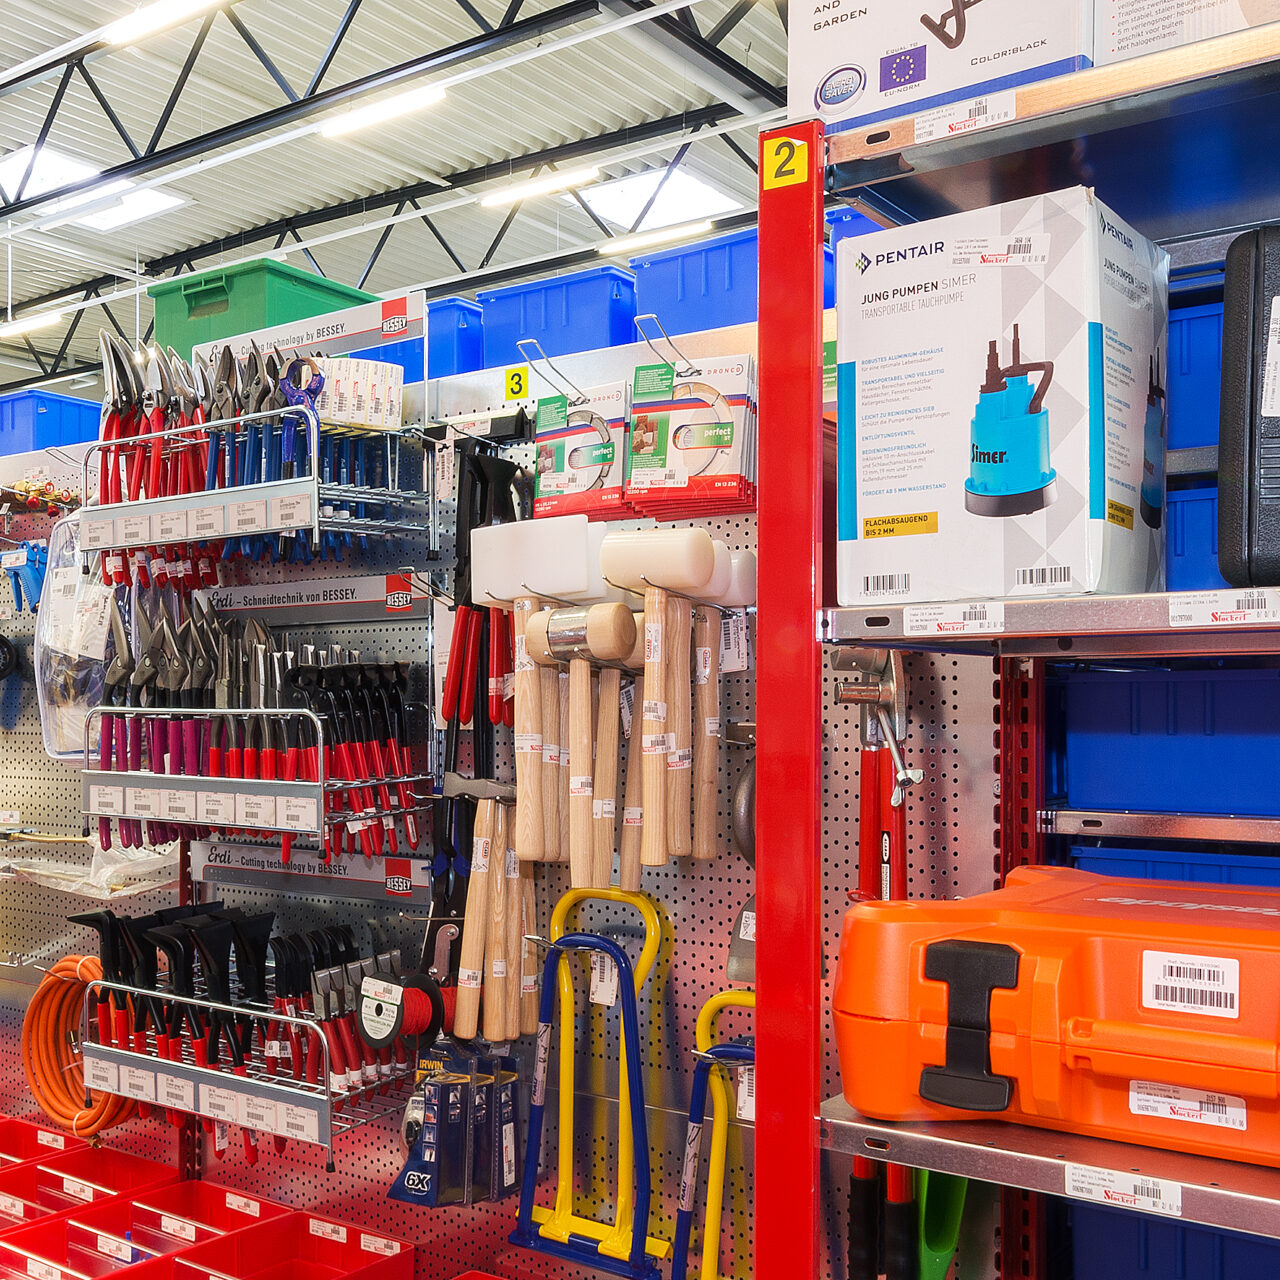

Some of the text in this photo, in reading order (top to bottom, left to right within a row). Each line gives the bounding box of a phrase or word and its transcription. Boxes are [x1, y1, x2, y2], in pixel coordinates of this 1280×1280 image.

[813, 0, 841, 15] AND
[813, 7, 868, 31] GARDEN
[1145, 26, 1160, 35] voor
[885, 45, 908, 55] EQUAL
[1117, 43, 1129, 51] Met
[824, 75, 856, 91] ENERGY
[884, 83, 921, 97] EU-NORM
[824, 85, 854, 100] SAVER
[773, 141, 796, 178] 2
[1106, 222, 1134, 251] PENTAIR
[875, 241, 945, 267] PENTAIR
[1103, 257, 1116, 274] JUNG
[1116, 265, 1135, 286] PUMPEN
[861, 273, 977, 305] JUNG PUMPEN SIMER
[861, 291, 964, 320] TRANSPORTABLE TAUCHPUMPE
[382, 317, 408, 333] BESSEY
[306, 332, 315, 341] by
[707, 366, 741, 375] DRONCO
[510, 373, 523, 395] 3
[703, 428, 731, 438] perfect
[592, 446, 613, 457] perfect
[971, 443, 1007, 464] Simer
[865, 515, 929, 527] FLACHABSAUGEND
[865, 526, 895, 537] BIS 2 MM
[210, 588, 357, 609] Erdi Schneidtechnik von BESSEY.
[386, 593, 412, 606] BESSEY
[207, 846, 234, 865] Erdi
[240, 856, 265, 868] Cutting
[307, 862, 316, 873] by
[386, 877, 411, 890] BESSEY
[419, 1060, 444, 1070] IRWIN
[405, 1171, 432, 1191] 6X
